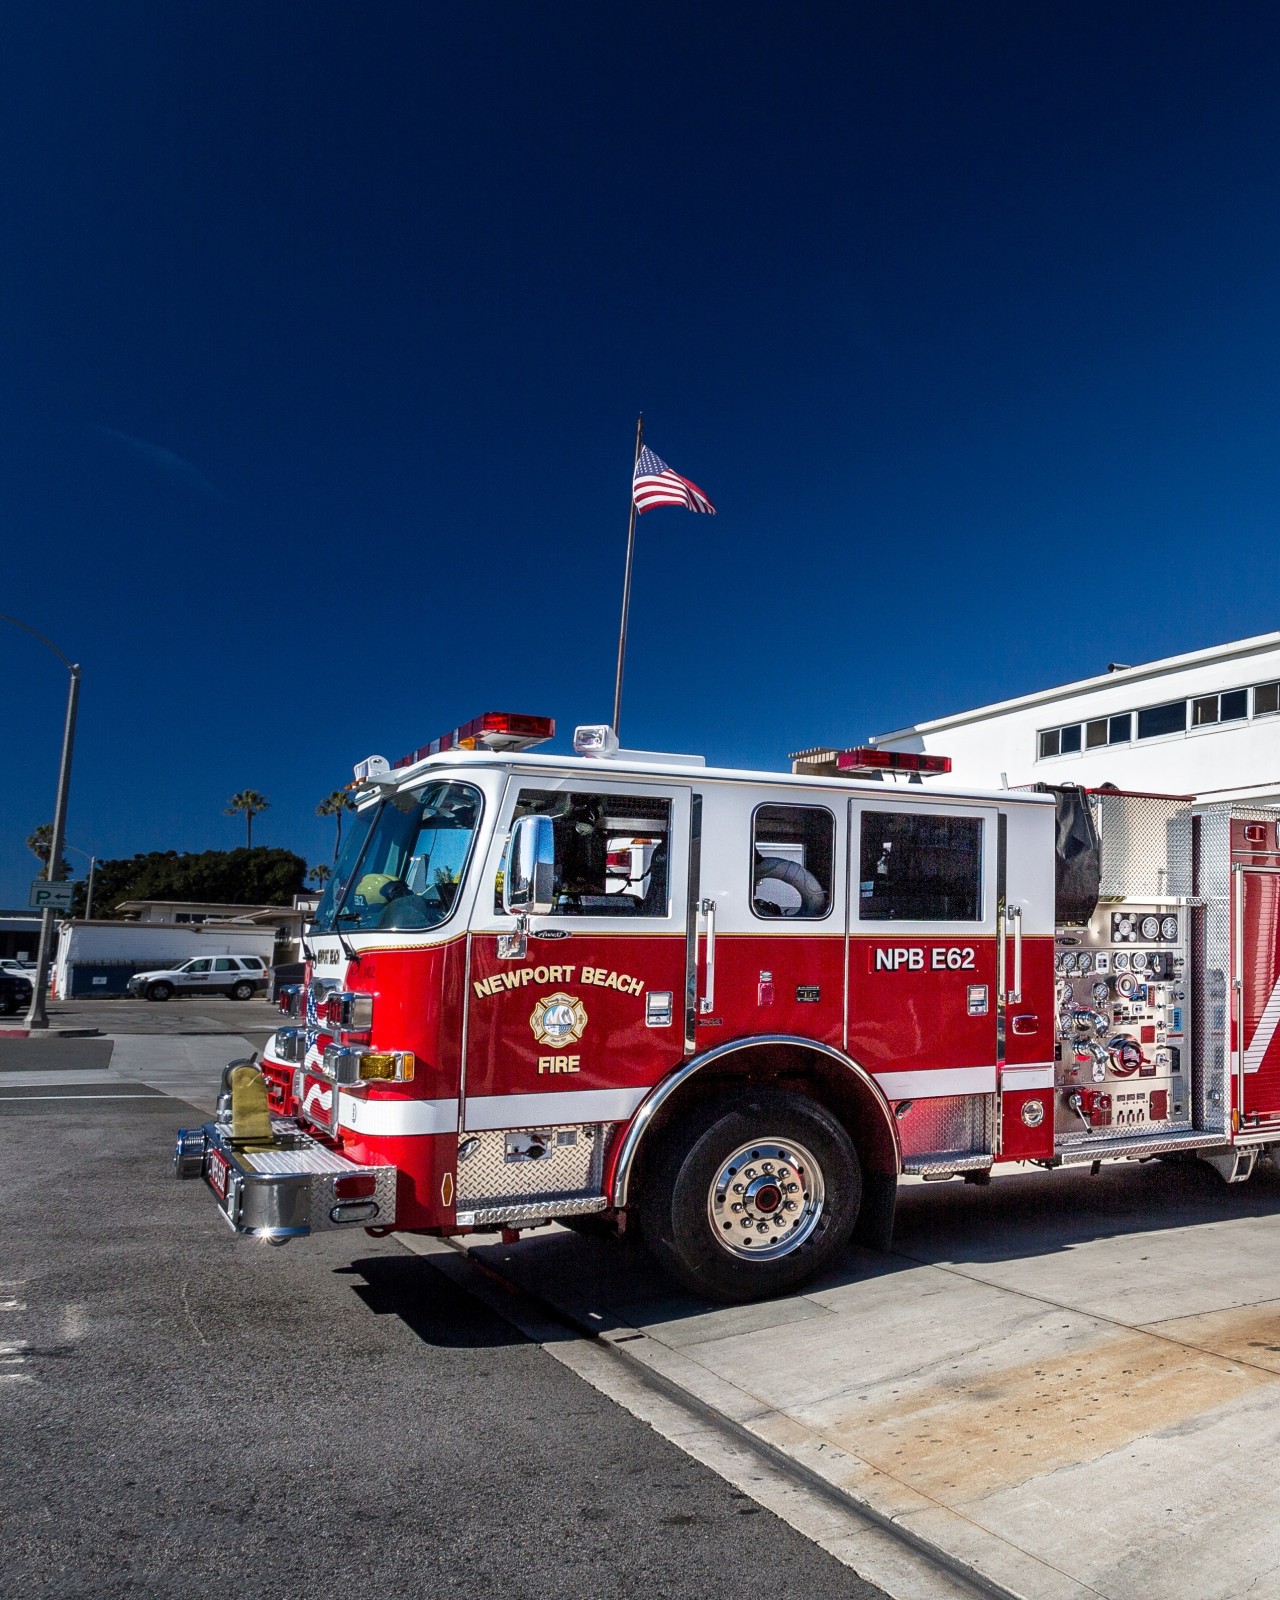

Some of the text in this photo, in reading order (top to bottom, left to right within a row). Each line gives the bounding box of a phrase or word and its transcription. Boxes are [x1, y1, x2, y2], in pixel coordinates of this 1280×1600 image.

[875, 947, 976, 971] NPB E62
[473, 965, 645, 999] NEWPORT BEACH
[538, 1055, 581, 1075] FIRE
